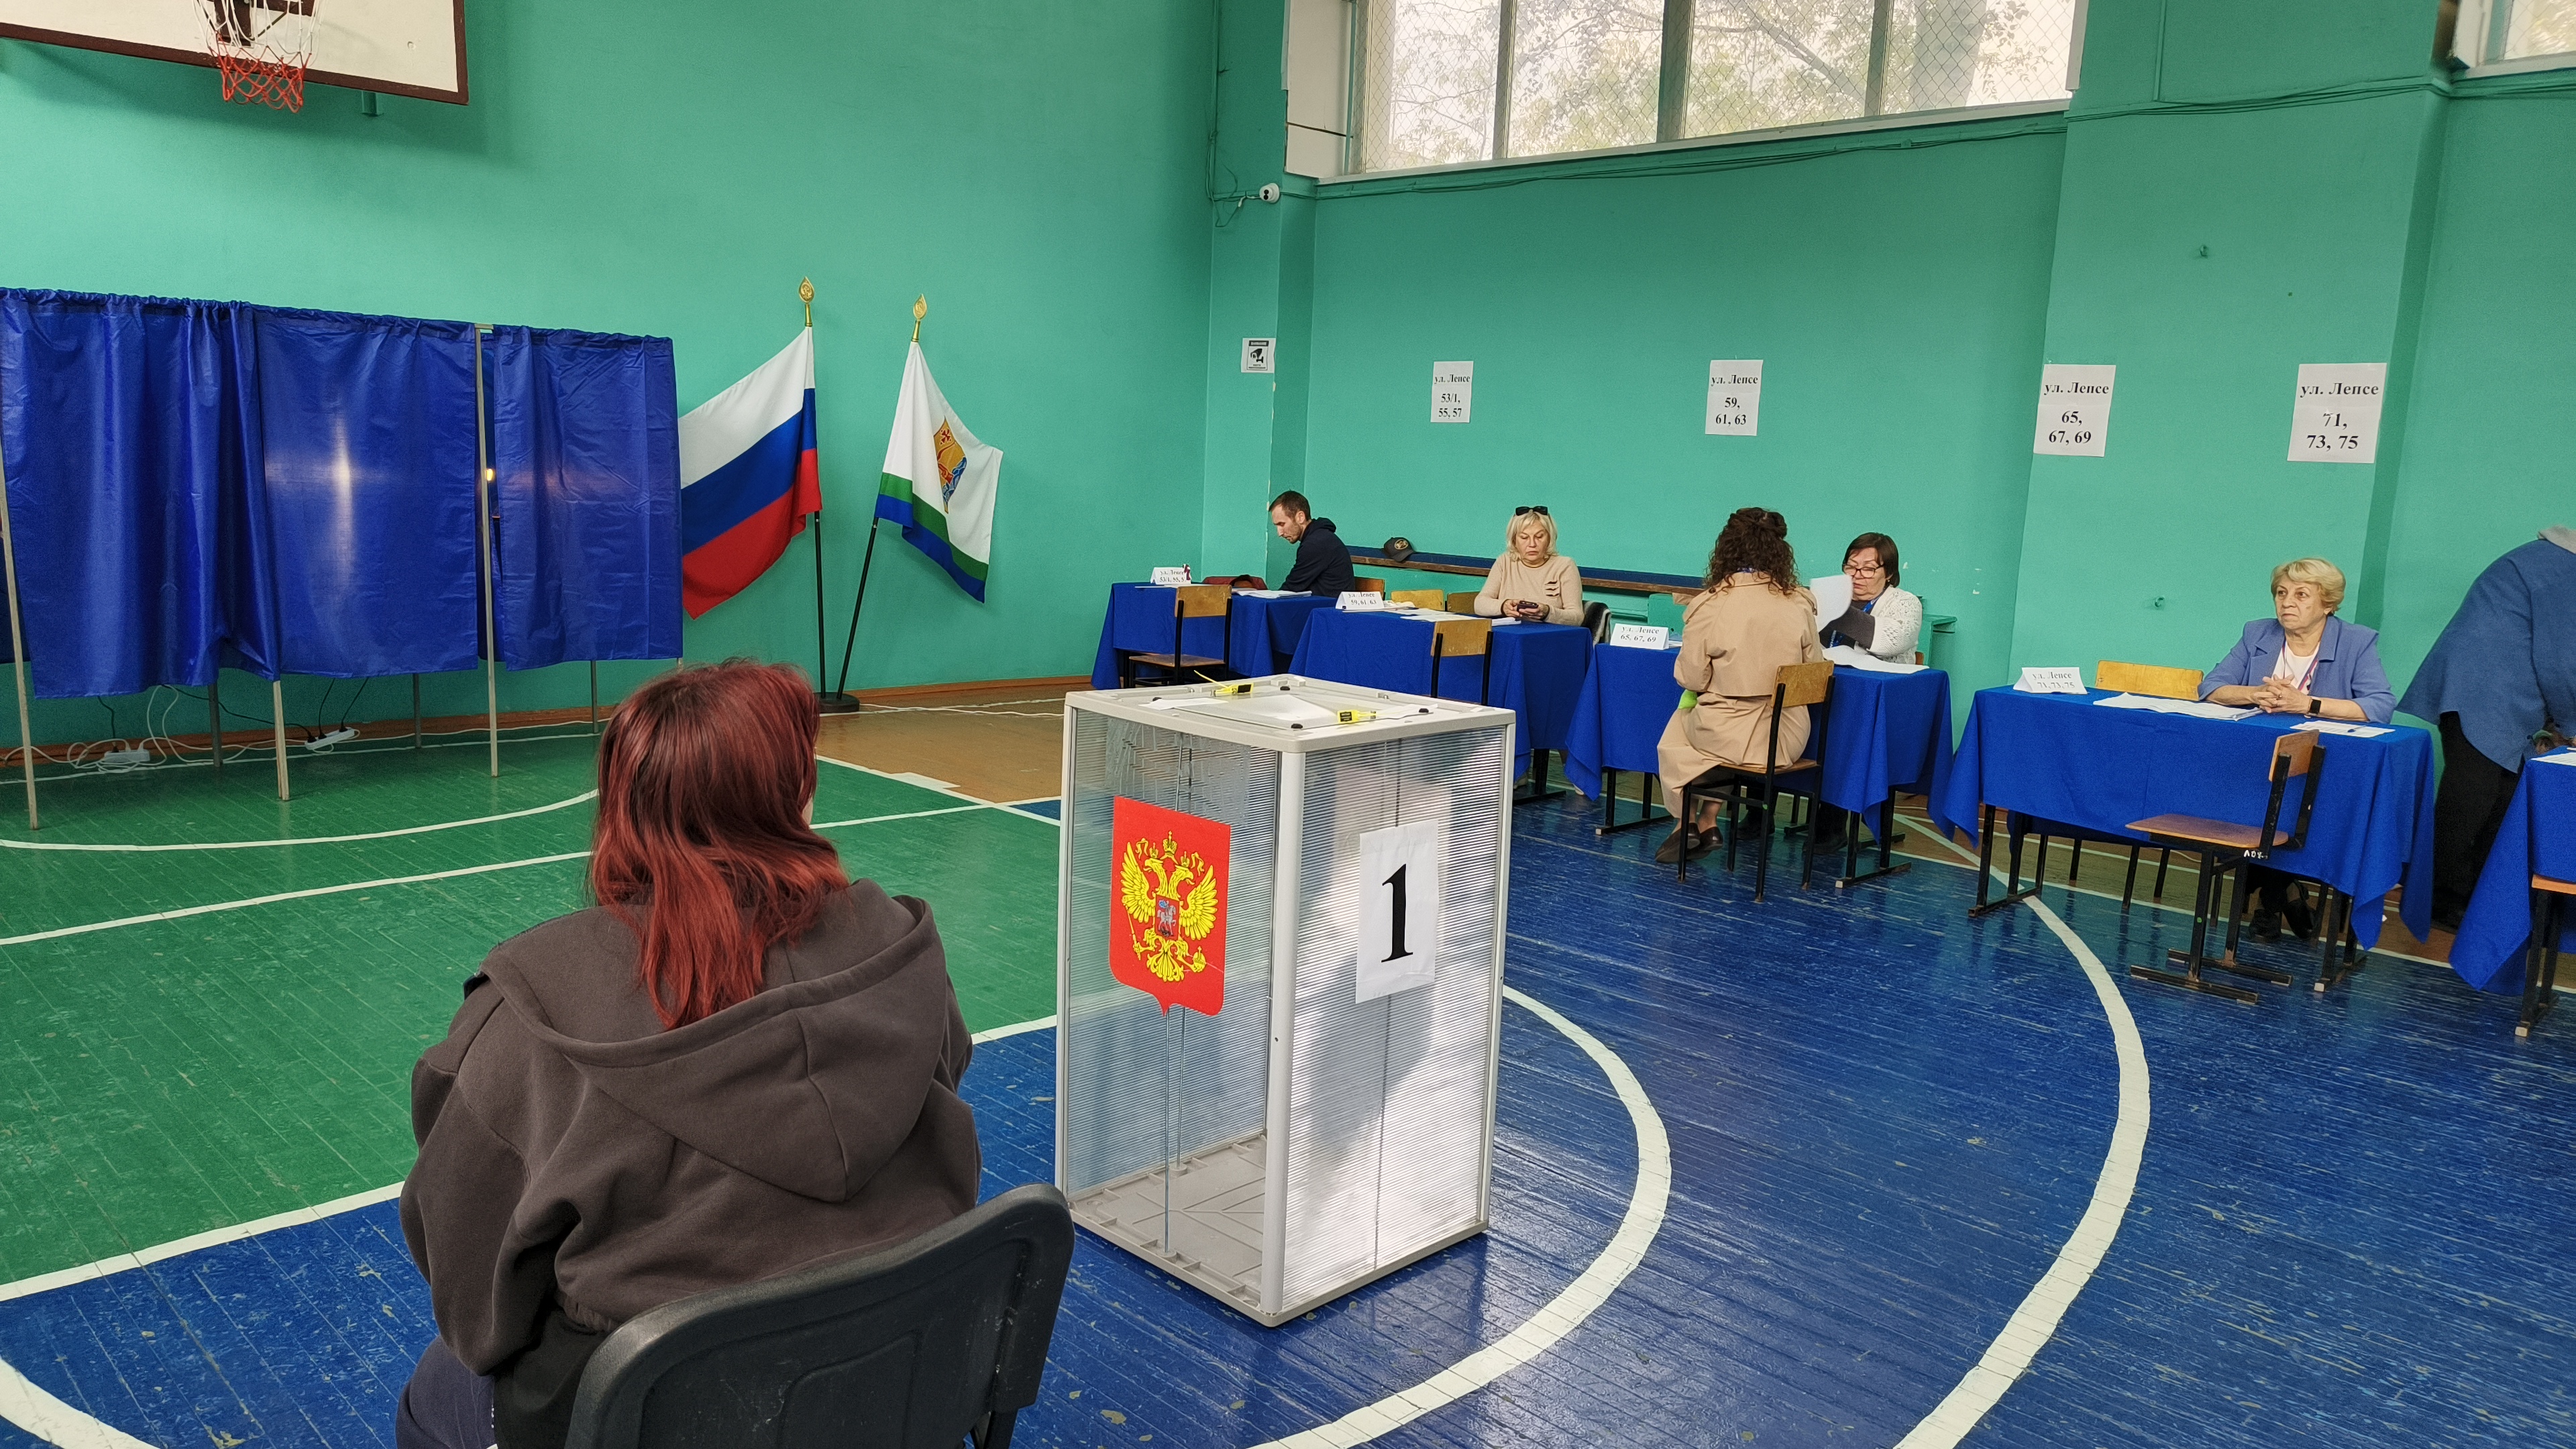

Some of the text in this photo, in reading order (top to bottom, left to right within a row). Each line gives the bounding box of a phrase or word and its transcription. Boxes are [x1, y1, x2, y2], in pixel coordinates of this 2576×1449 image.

[1434, 374, 1470, 384] ул. Лепсе
[1711, 374, 1758, 387] ул. Лепсе
[2043, 382, 2109, 396] ул. Лепсе
[2300, 382, 2379, 398] ул. Лепсе
[1440, 393, 1460, 405] 53/1,
[1724, 397, 1740, 411] 59,
[1438, 408, 1462, 419] 55, 57
[1715, 413, 1746, 427] 61, 63
[2061, 411, 2082, 426] 65,
[2322, 413, 2347, 430] 71,
[2049, 430, 2092, 445] 67, 69
[2306, 435, 2359, 451] 73, 75
[1381, 863, 1413, 963] 1
